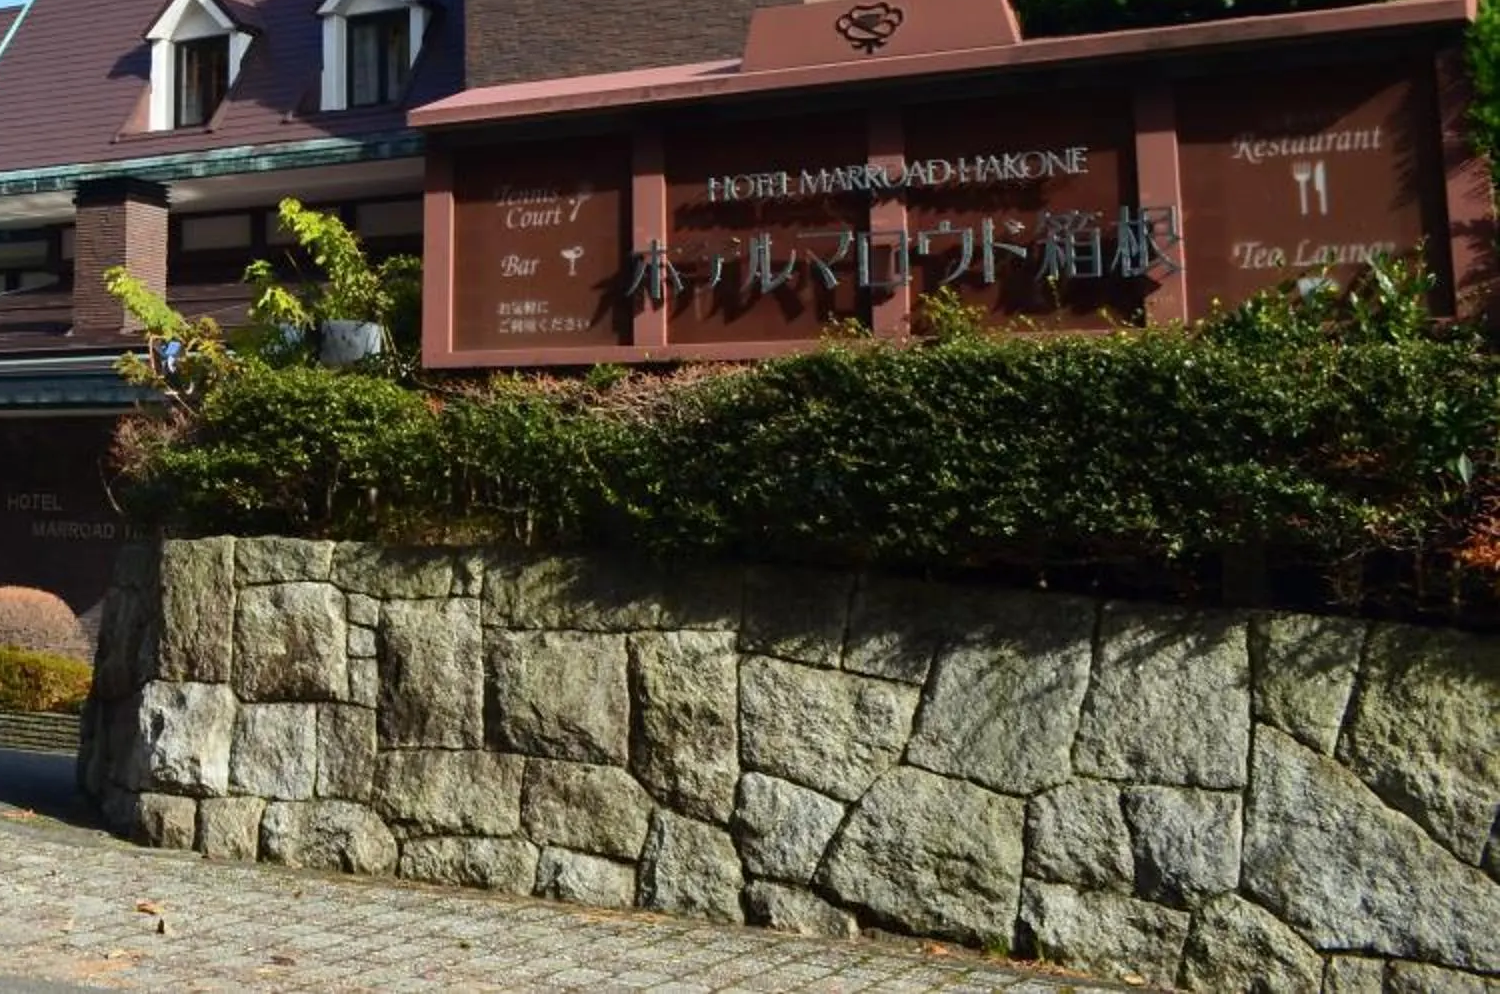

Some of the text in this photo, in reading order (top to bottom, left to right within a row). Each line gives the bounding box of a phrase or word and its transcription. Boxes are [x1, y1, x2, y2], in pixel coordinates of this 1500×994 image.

[1233, 125, 1382, 164] Restaurant
[707, 146, 1090, 203] HOTEL MARROAD HAKONE
[505, 206, 563, 229] Court
[501, 253, 541, 278] Bar
[1232, 241, 1287, 269] Tea
[7, 492, 64, 512] HOTEL
